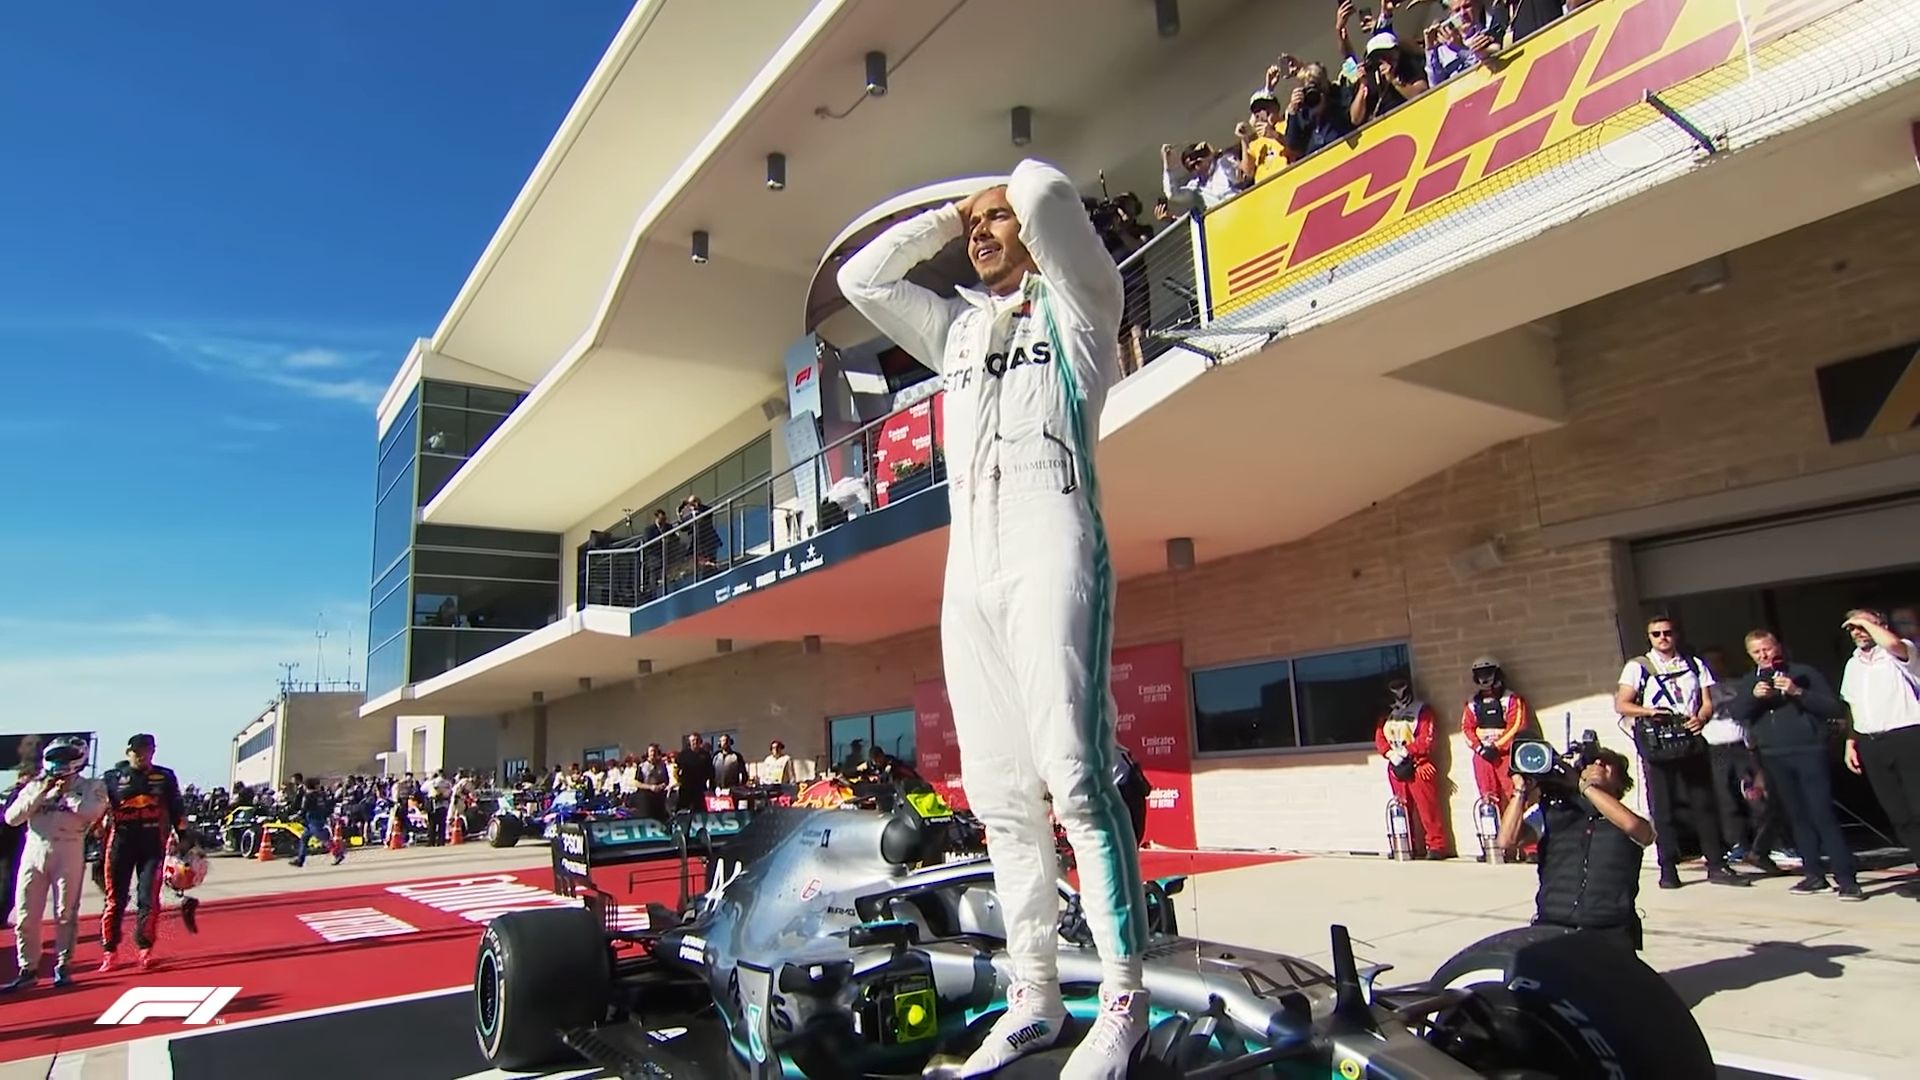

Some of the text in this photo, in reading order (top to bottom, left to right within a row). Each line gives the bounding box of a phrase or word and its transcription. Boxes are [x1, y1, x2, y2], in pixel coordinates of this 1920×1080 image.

[1286, 0, 1750, 269] DHL
[1014, 459, 1067, 473] HAMILTON
[1006, 1023, 1045, 1050] PUMA
